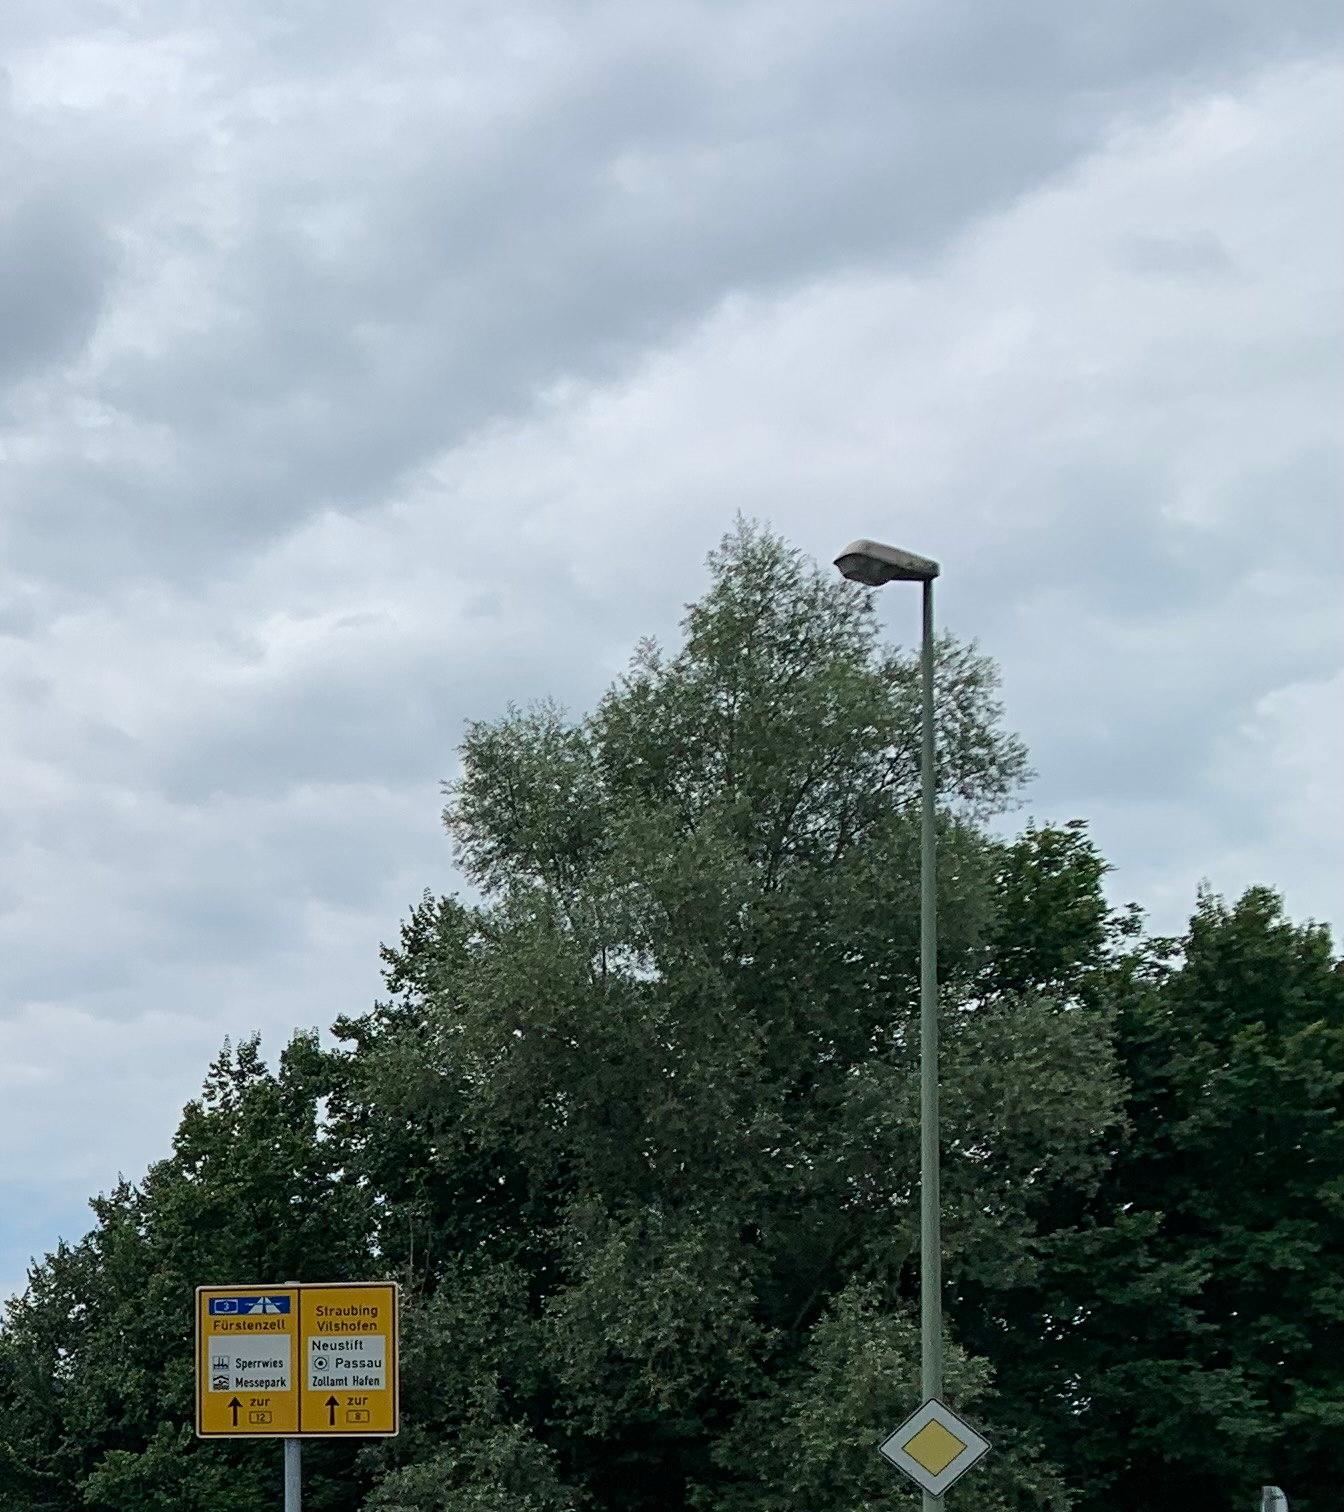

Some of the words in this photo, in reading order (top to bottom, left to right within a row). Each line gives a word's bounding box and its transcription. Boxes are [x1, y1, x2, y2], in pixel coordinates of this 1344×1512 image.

[223, 1301, 230, 1311] 3
[315, 1305, 379, 1318] Straubing
[213, 1318, 286, 1331] Fürstenzell
[316, 1320, 378, 1332] Vilshofen
[312, 1339, 364, 1351] Neustift
[235, 1357, 284, 1371] Sperrwies
[335, 1357, 382, 1369] Passau
[235, 1376, 287, 1389] Messepark
[312, 1375, 348, 1387] Zollamt
[352, 1375, 380, 1386] Hafen
[249, 1398, 271, 1407] zur
[347, 1397, 369, 1406] zur
[255, 1413, 266, 1422] 12
